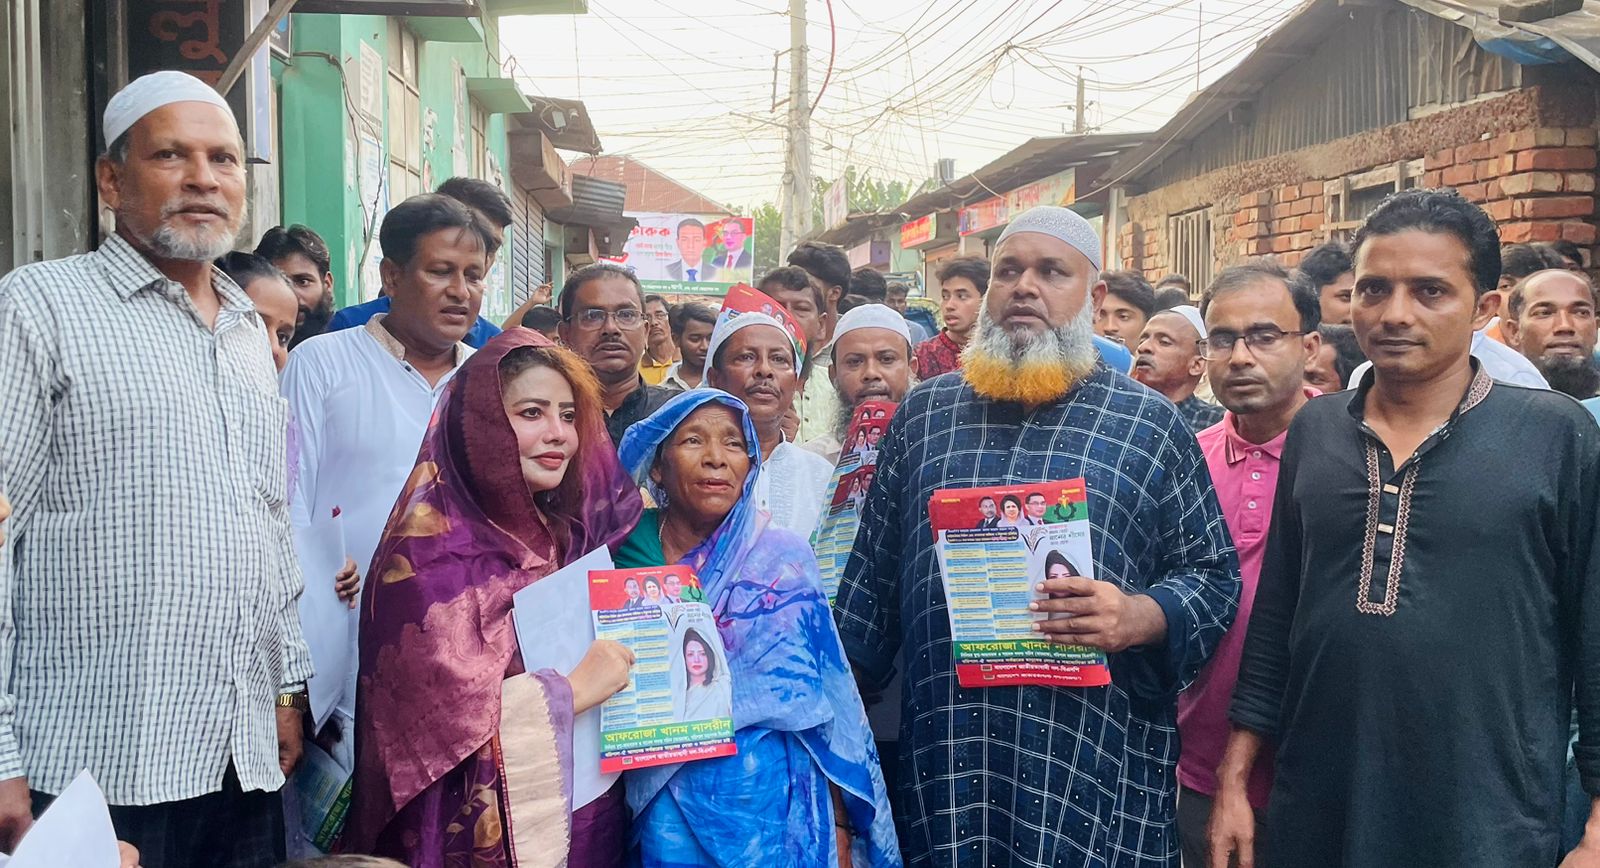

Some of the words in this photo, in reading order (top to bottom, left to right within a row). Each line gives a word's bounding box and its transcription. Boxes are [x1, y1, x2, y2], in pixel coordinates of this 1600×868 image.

[959, 642, 1016, 651] আফরোজা
[1020, 641, 1051, 650] খানম
[1053, 643, 1096, 653] নাসর
[605, 728, 657, 743] আফরোজা
[660, 724, 688, 737] খানম
